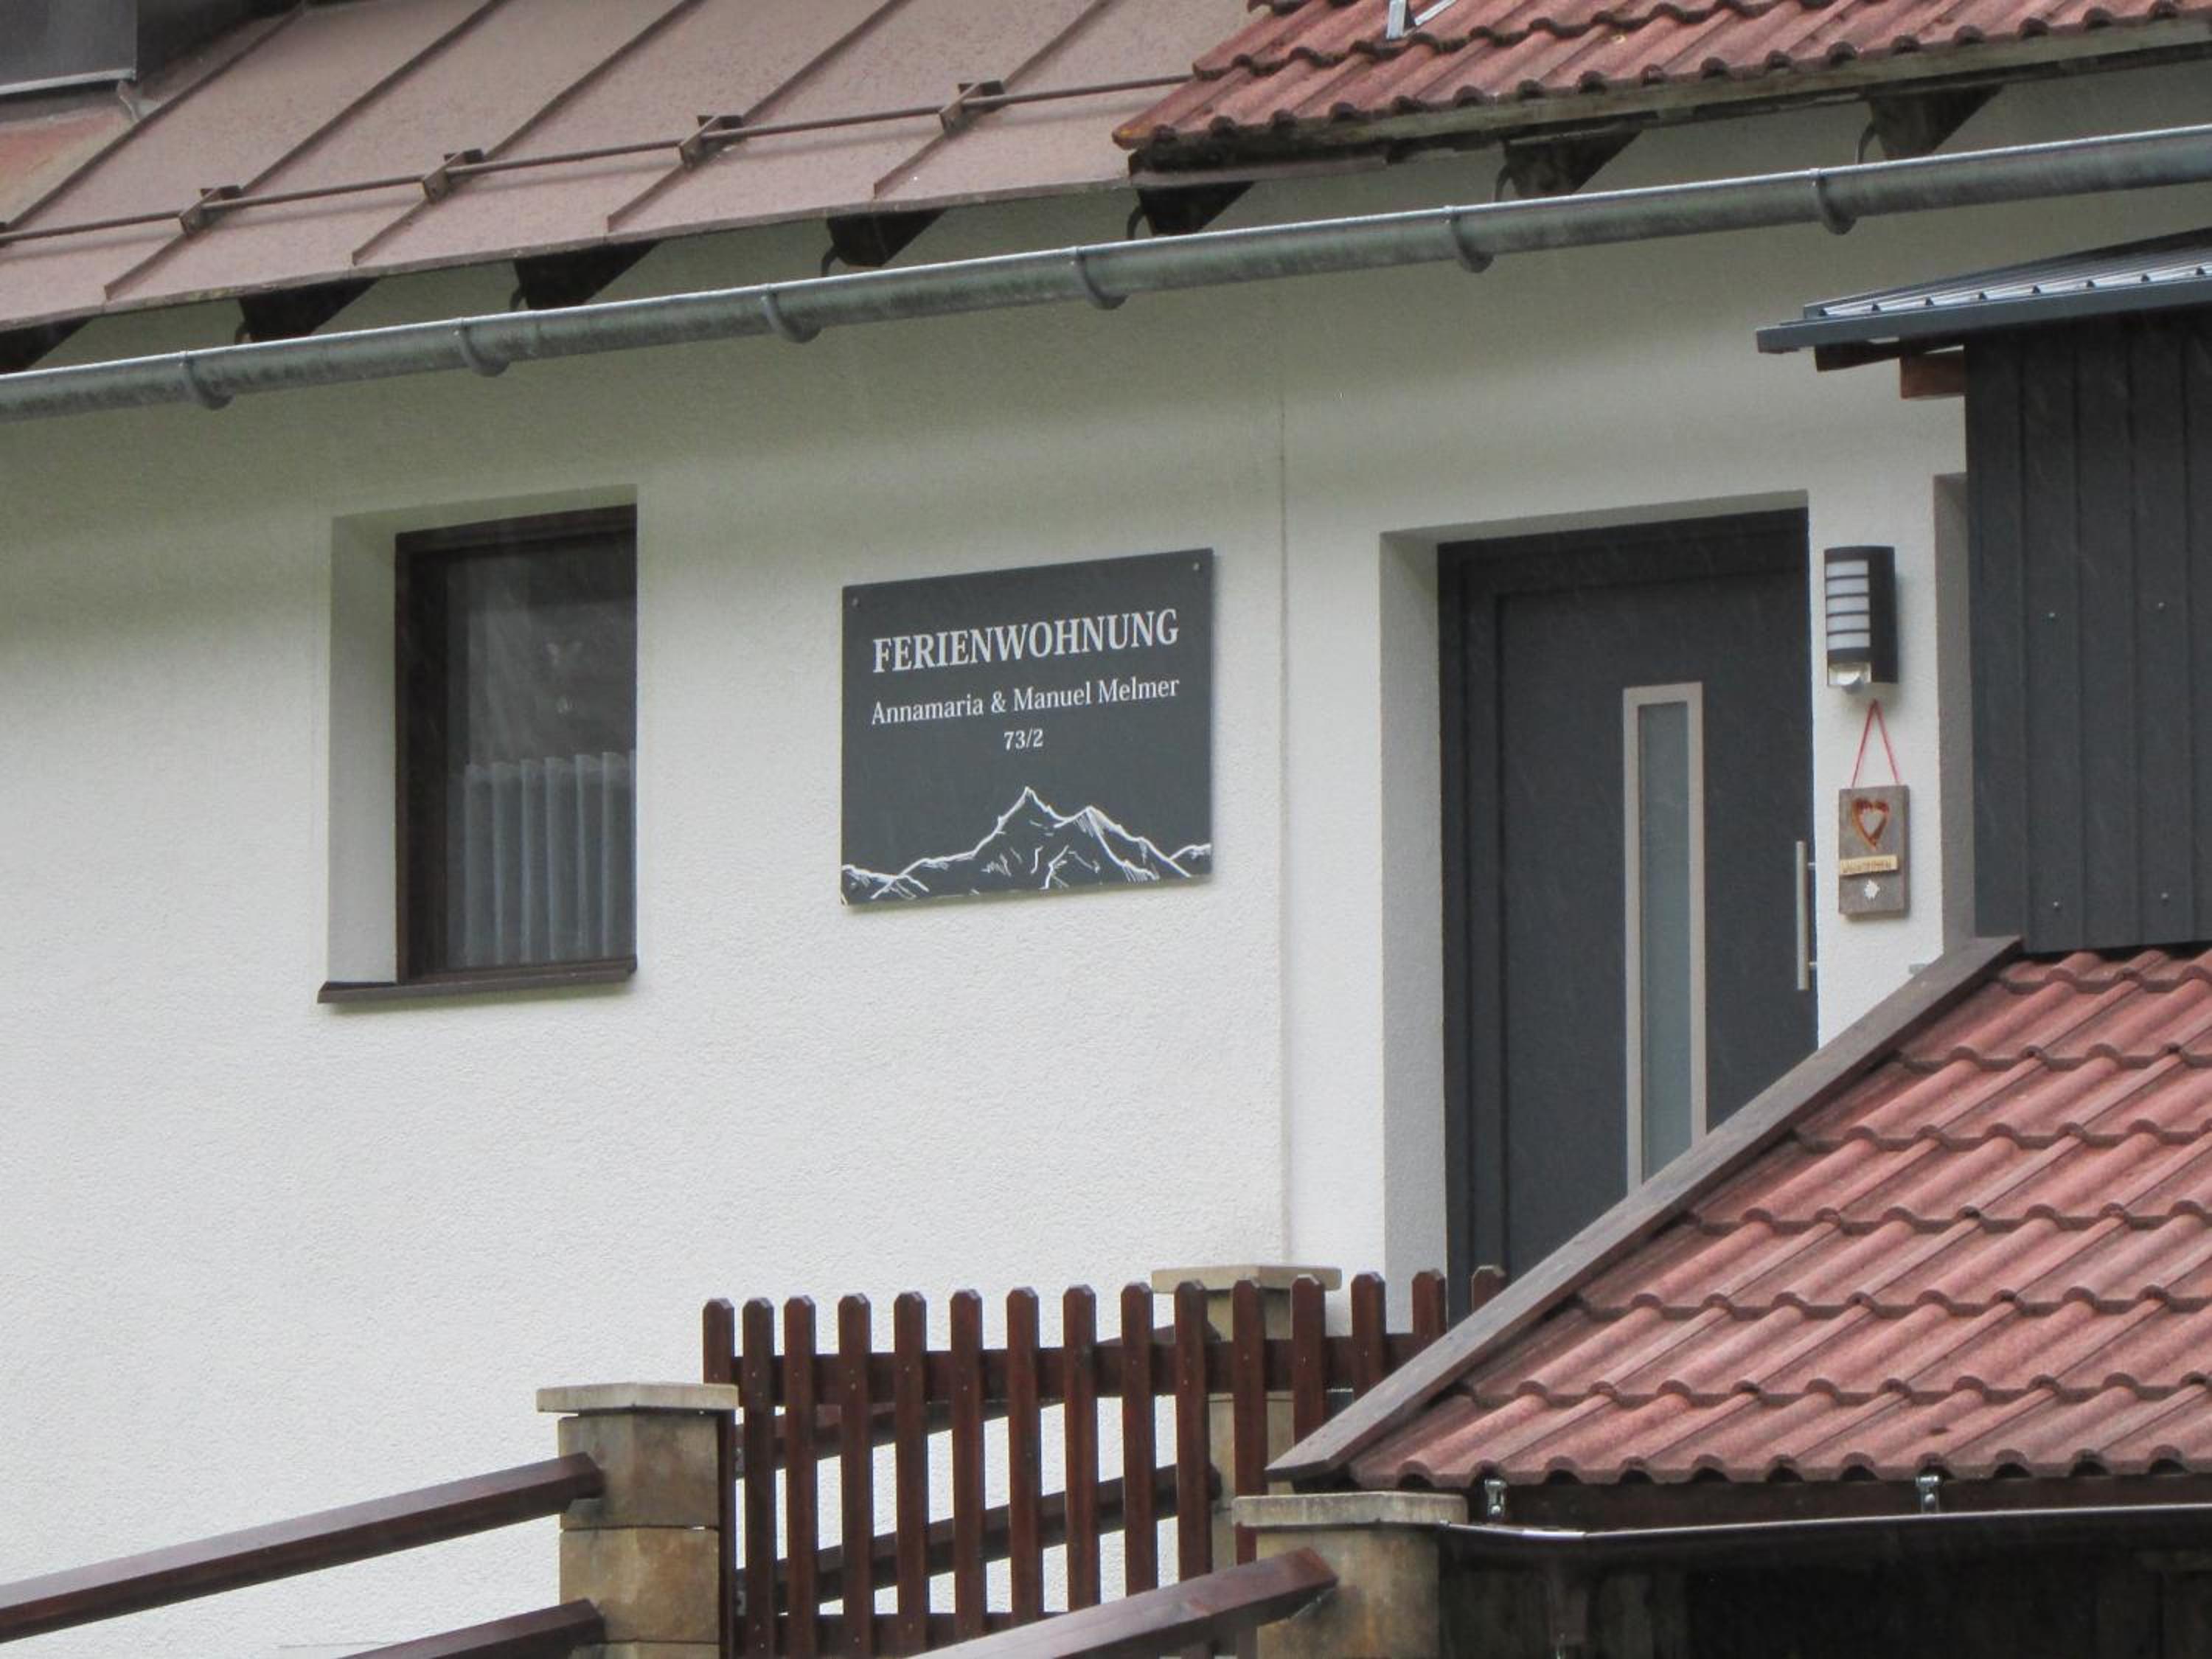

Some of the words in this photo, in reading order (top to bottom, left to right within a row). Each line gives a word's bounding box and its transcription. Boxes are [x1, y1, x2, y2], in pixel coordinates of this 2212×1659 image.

[872, 608, 1179, 673] FERIENWOHNUNG
[872, 693, 984, 725] Annamaria
[991, 690, 1007, 713] &
[1014, 681, 1091, 712] Manuel
[1097, 676, 1180, 703] Melmer
[1004, 728, 1043, 751] 73/2
